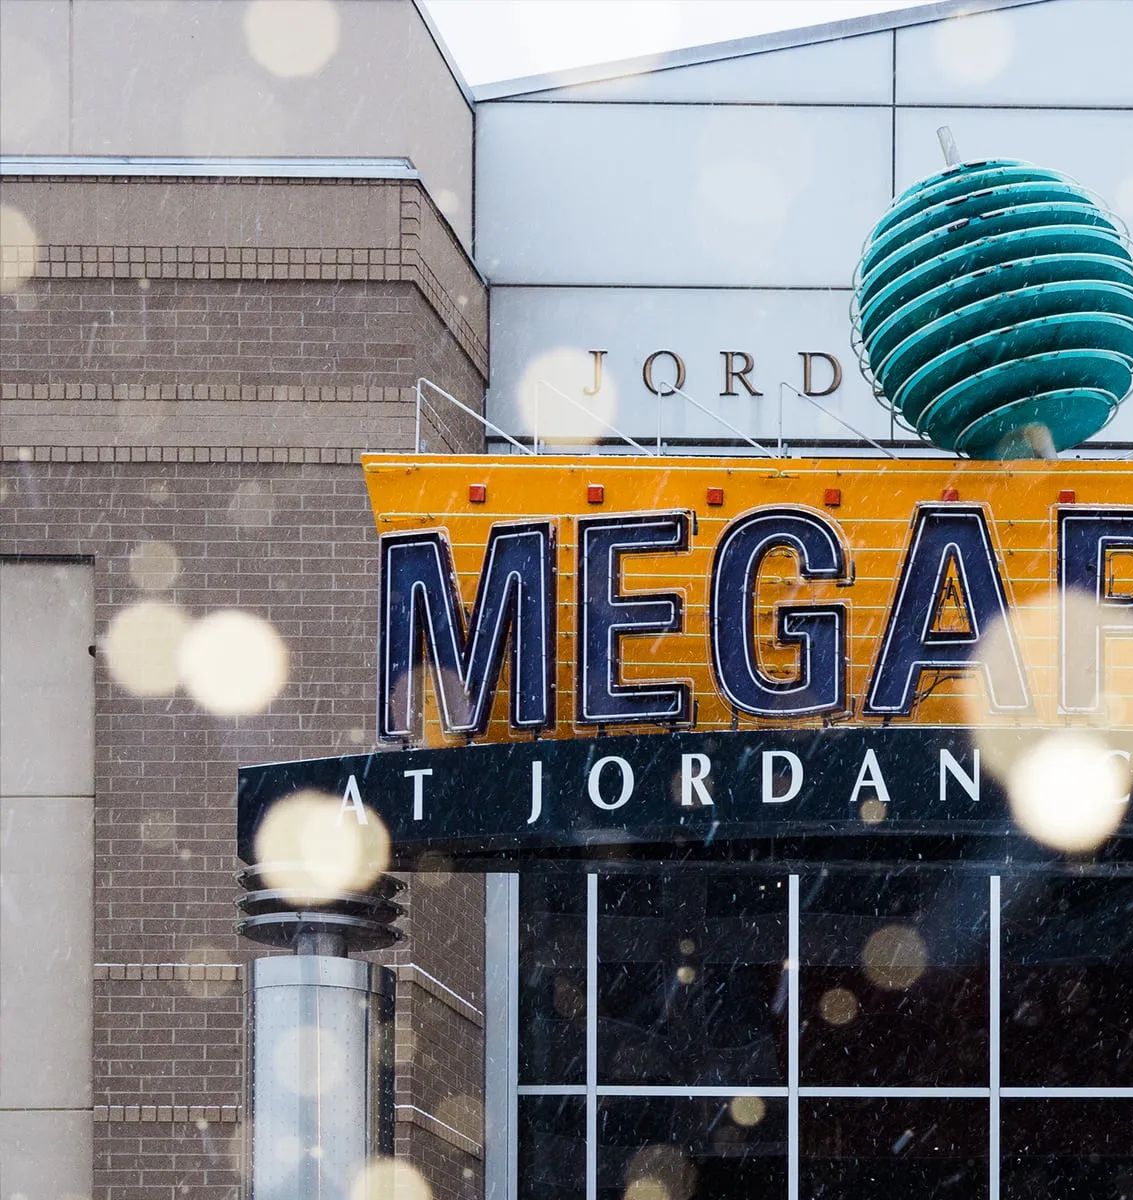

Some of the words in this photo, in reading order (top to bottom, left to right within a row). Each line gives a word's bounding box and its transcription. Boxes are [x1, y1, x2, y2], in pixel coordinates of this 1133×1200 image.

[583, 349, 886, 397] JORD
[336, 768, 433, 827] AT
[527, 748, 981, 825] JORDAN
